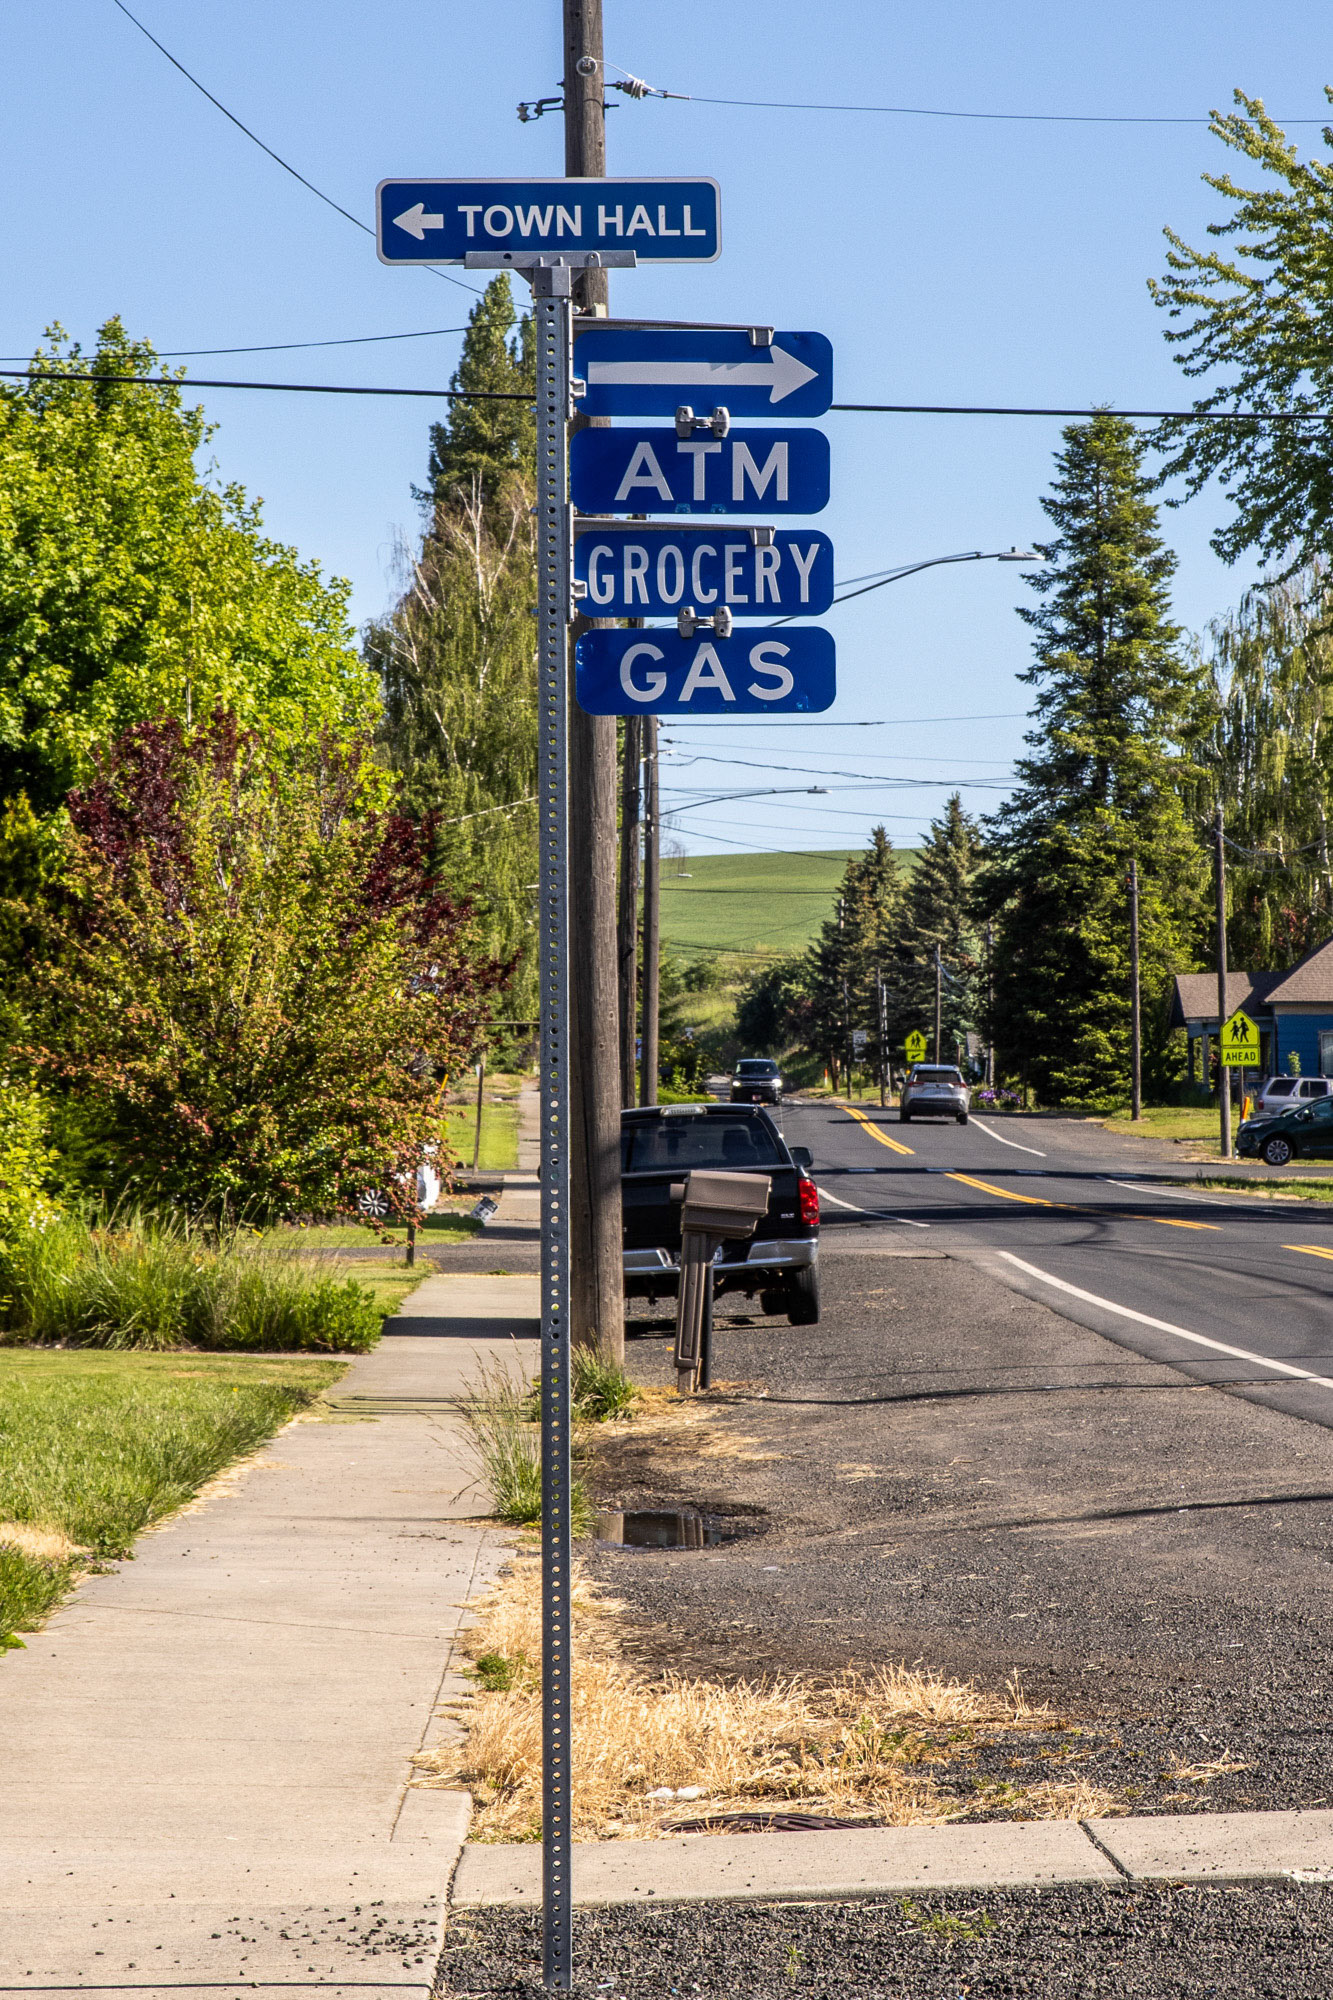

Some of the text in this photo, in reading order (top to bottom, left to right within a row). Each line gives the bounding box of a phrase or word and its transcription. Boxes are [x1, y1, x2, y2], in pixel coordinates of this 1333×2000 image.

[457, 204, 706, 237] TOWN HALL
[613, 441, 789, 501] ATM
[587, 543, 820, 605] GROCERY
[619, 640, 794, 702] GAS
[1225, 1051, 1256, 1061] AHEAD
